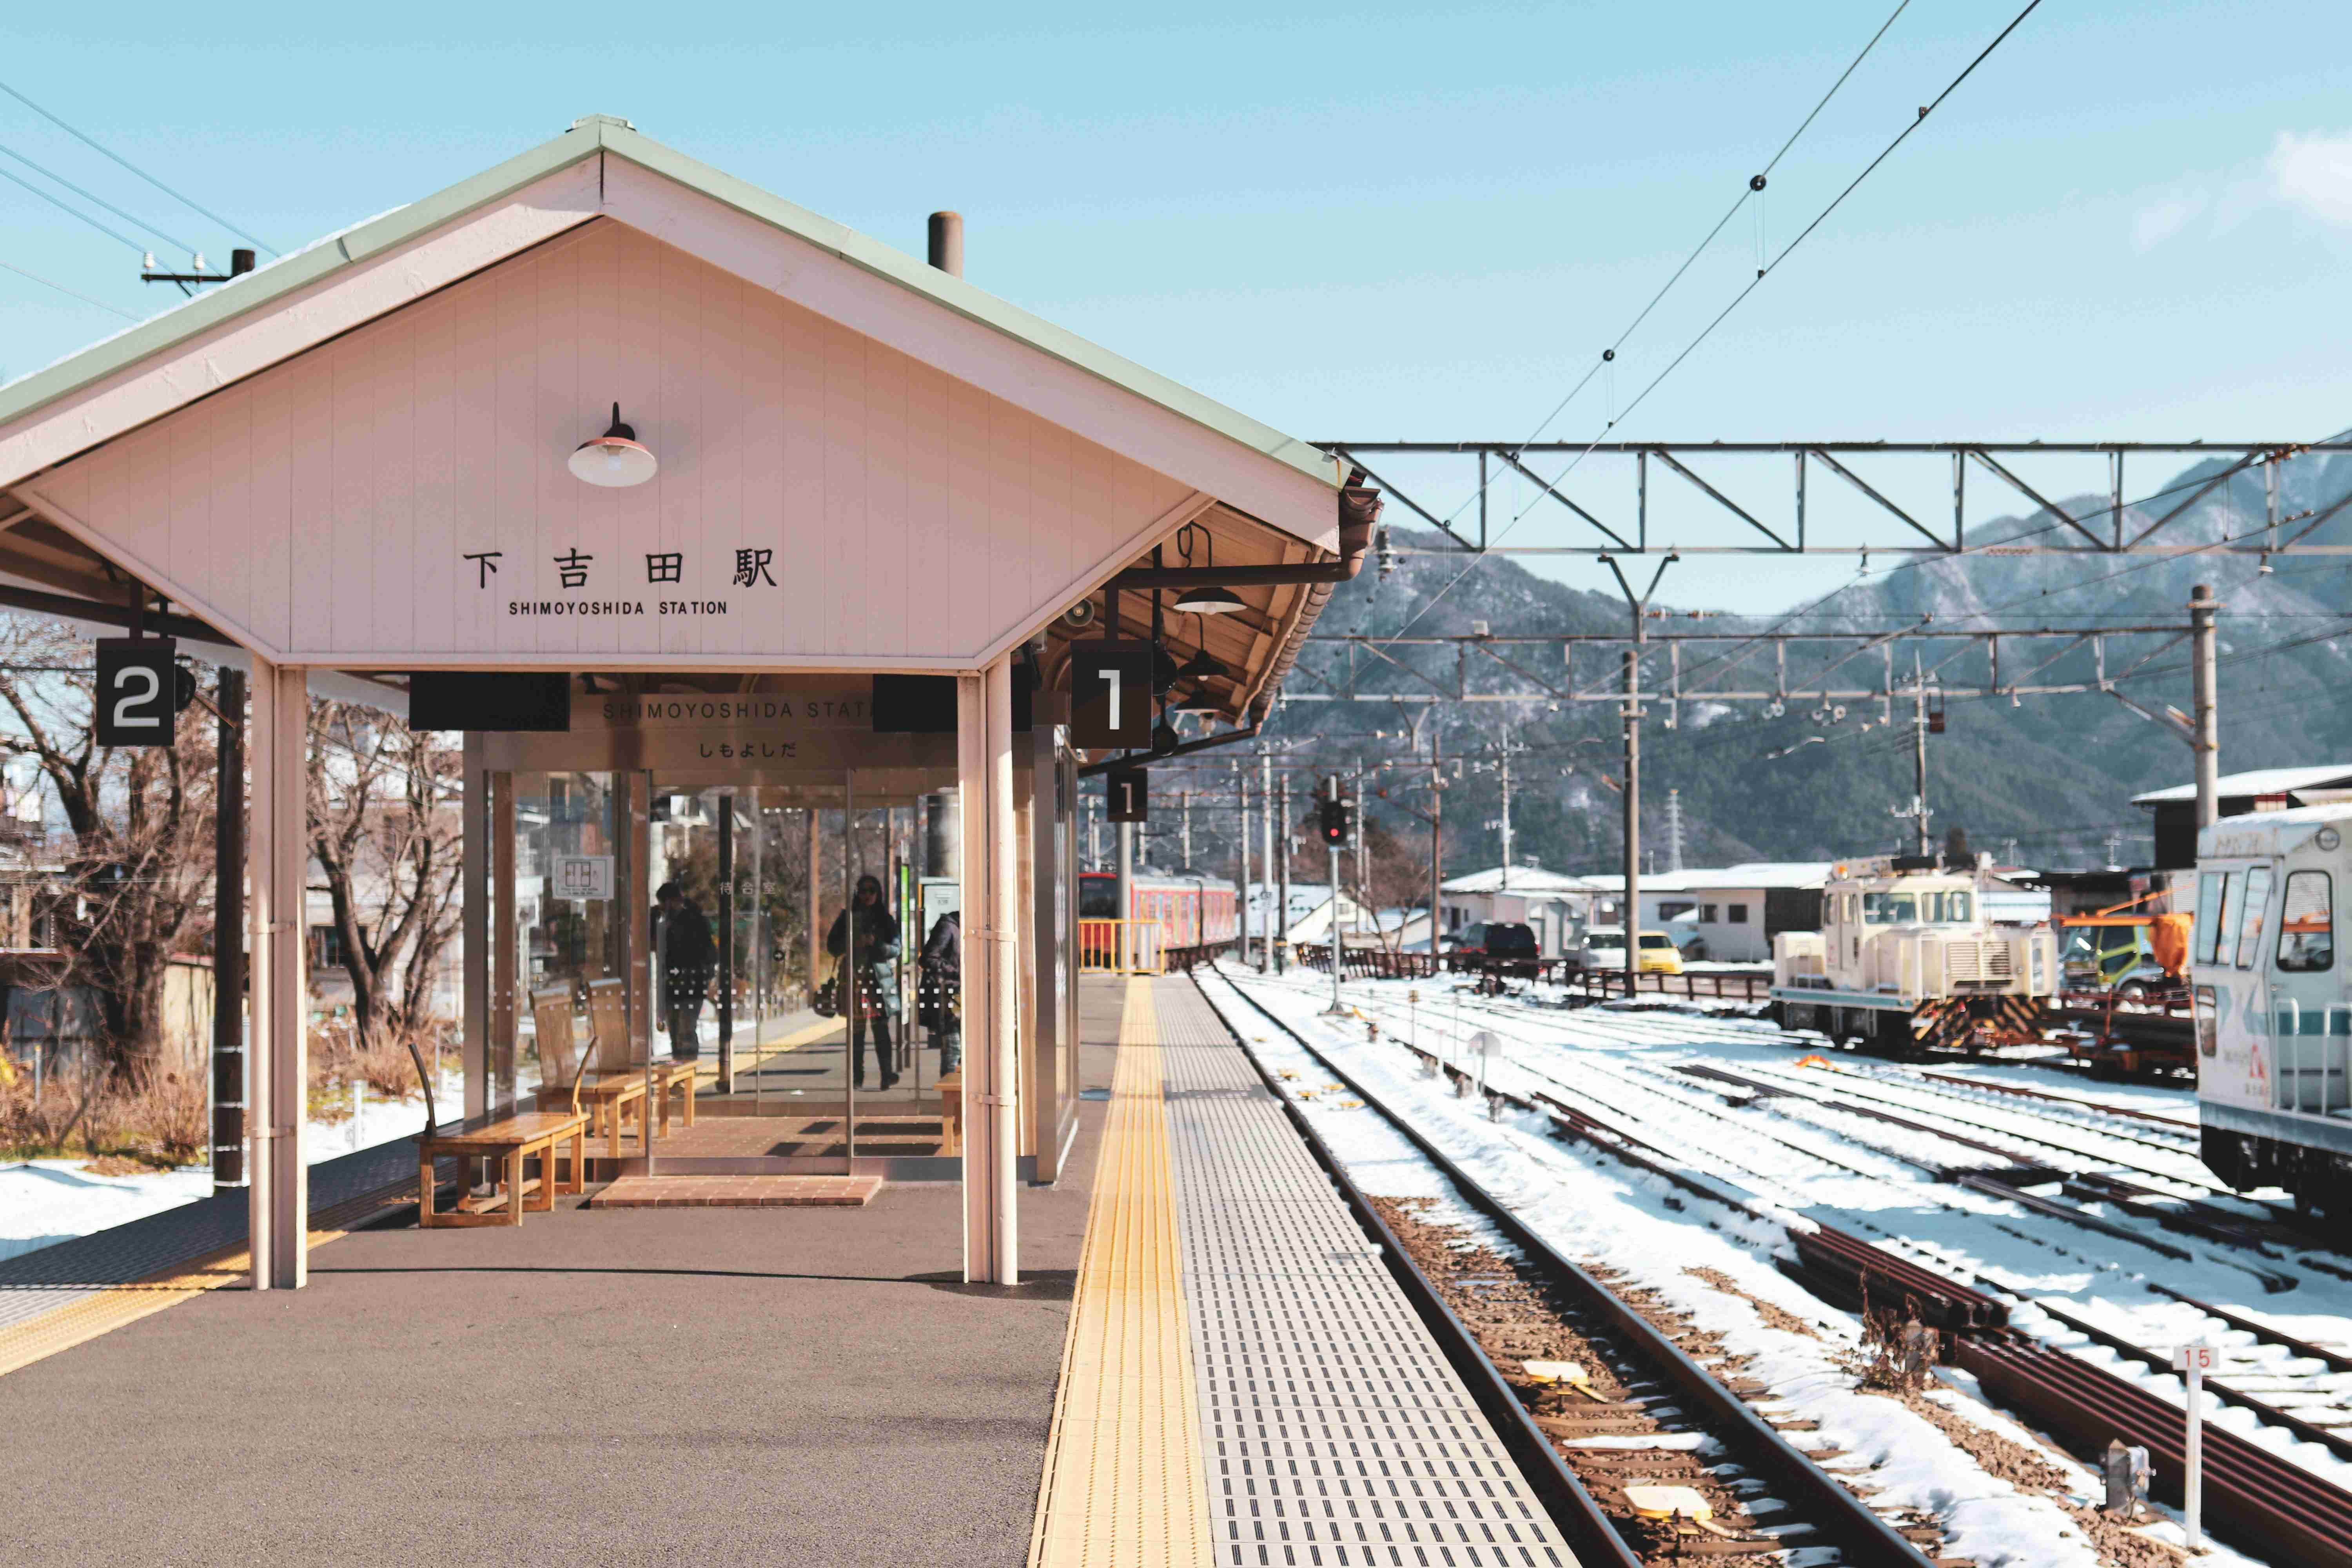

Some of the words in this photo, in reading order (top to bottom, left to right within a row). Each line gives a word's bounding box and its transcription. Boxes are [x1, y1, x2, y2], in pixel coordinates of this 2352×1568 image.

[463, 548, 777, 589] 下吉田駅
[509, 602, 644, 615] SHIMOYOSHIDA
[659, 602, 727, 615] STATION
[114, 666, 160, 727] 2
[1099, 670, 1120, 730] 1
[604, 703, 793, 719] SHIMOYOSHIDA
[700, 742, 797, 759] しもよしだ
[1121, 783, 1132, 813] 1
[2185, 1349, 2210, 1367] 15
